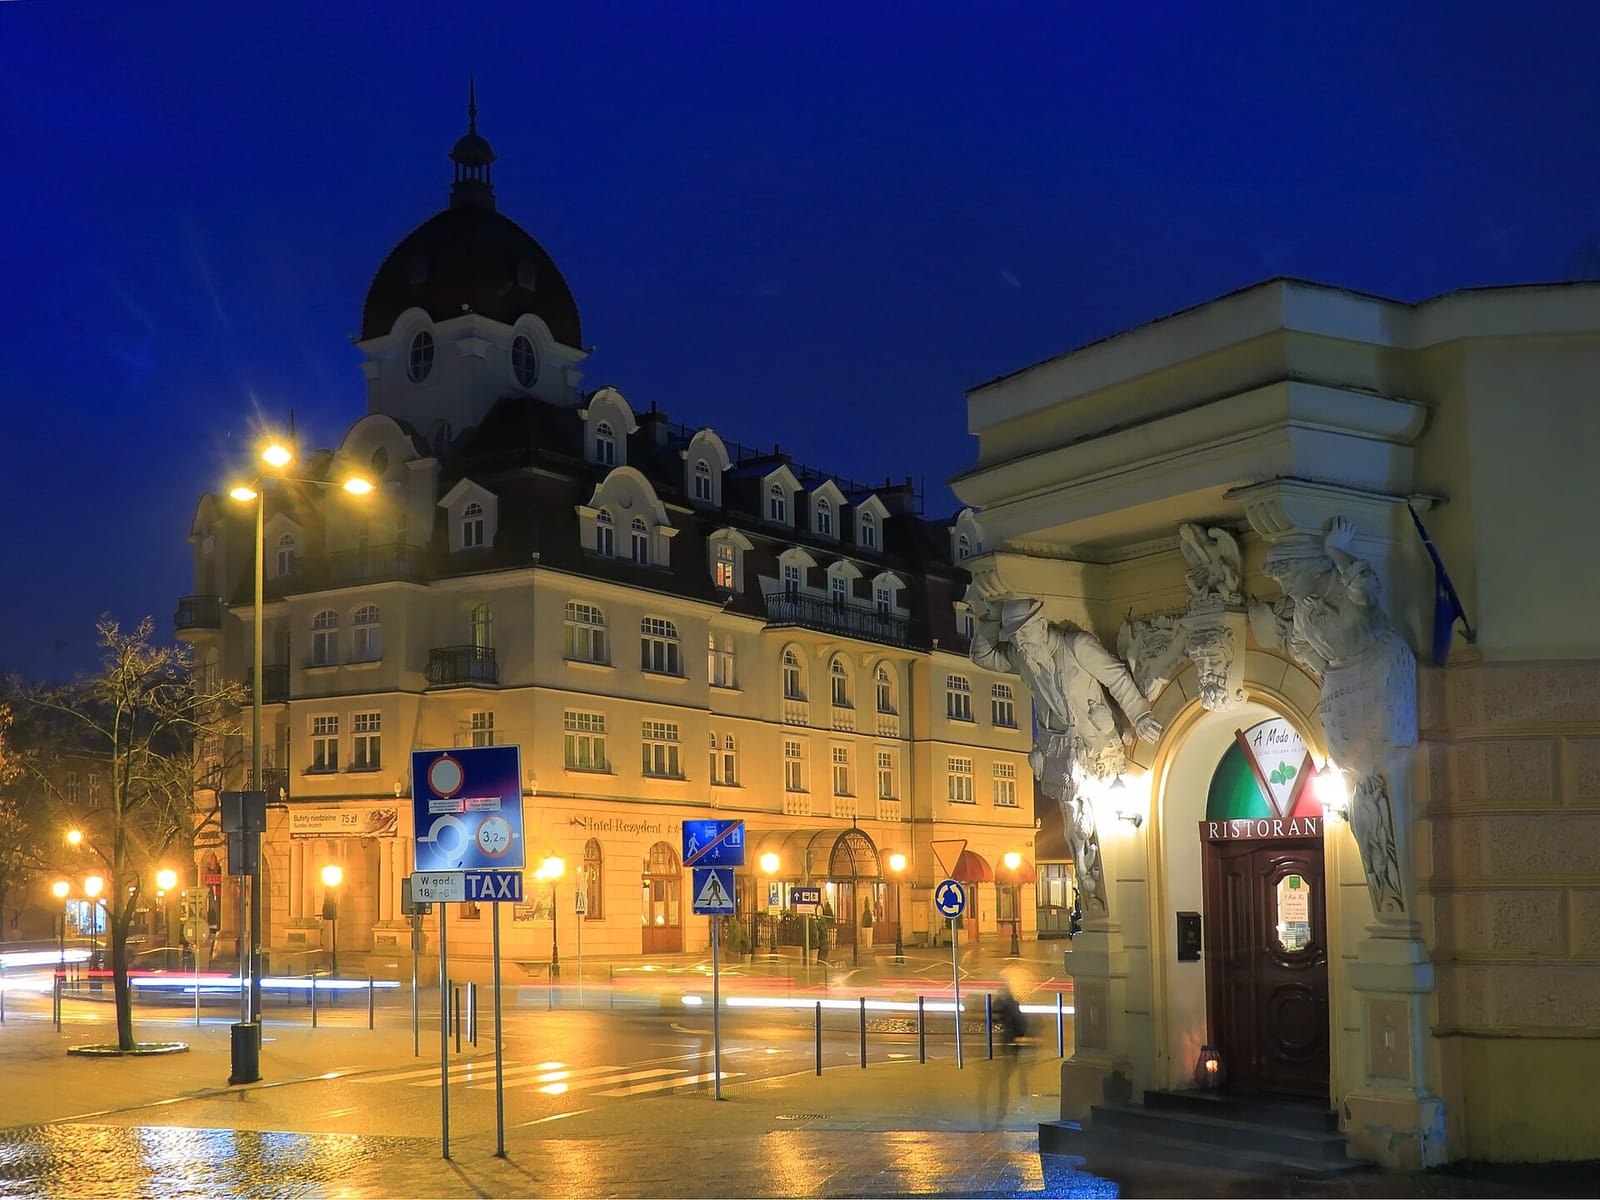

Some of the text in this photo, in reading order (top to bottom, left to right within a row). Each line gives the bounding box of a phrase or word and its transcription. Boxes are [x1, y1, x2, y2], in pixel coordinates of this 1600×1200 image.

[1254, 730, 1263, 746] A
[1266, 727, 1289, 746] Modo
[293, 814, 310, 823] Bufety
[340, 814, 350, 823] 75
[584, 816, 662, 836] Hotel Rezydent
[1208, 817, 1323, 839] RISTORAN
[420, 876, 429, 885] W
[466, 875, 520, 898] TAXI
